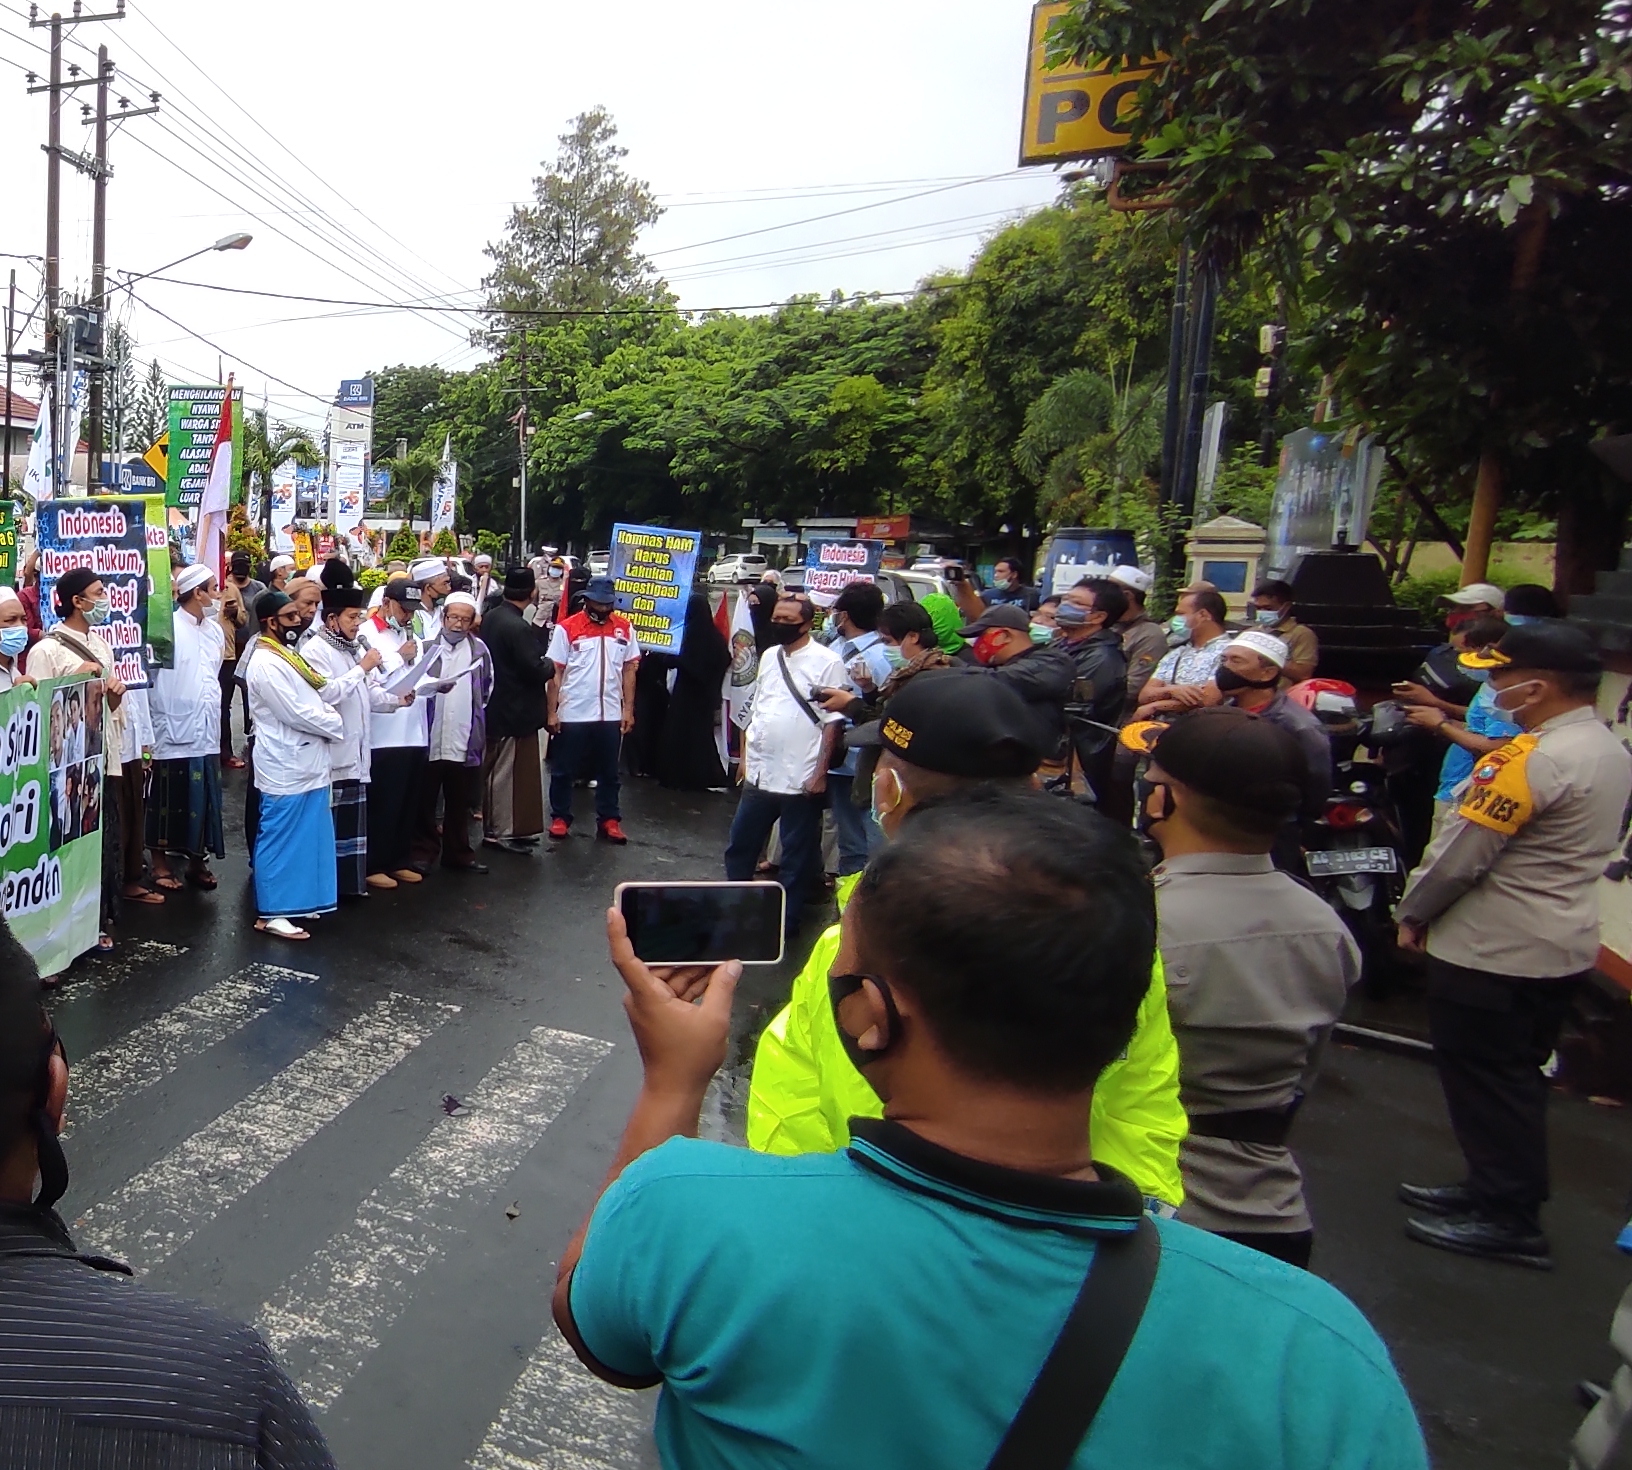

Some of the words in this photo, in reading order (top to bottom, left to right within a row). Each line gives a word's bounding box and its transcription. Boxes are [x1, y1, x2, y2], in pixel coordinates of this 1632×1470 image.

[170, 389, 241, 400] MENGHILANGAN
[191, 404, 220, 415] NYAWA
[180, 418, 209, 430] WARGA
[345, 422, 364, 430] ATM
[188, 463, 209, 474] ADAL
[179, 492, 200, 504] LUAR
[60, 507, 125, 536] Indonesia
[6, 530, 14, 546] 6
[146, 527, 165, 546] kta
[618, 530, 664, 548] Komnas
[665, 536, 694, 552] HAM
[45, 552, 94, 574] Negara
[96, 549, 144, 576] Hukum,
[634, 549, 670, 565] Harus
[821, 545, 866, 563] Indonesia
[625, 563, 674, 581] Lakukan
[806, 569, 839, 591] Negara
[109, 580, 136, 615] Bagi
[614, 578, 679, 599] Investigasi
[633, 596, 655, 612] dan
[114, 618, 140, 645] Main
[114, 654, 144, 683] ndiri.
